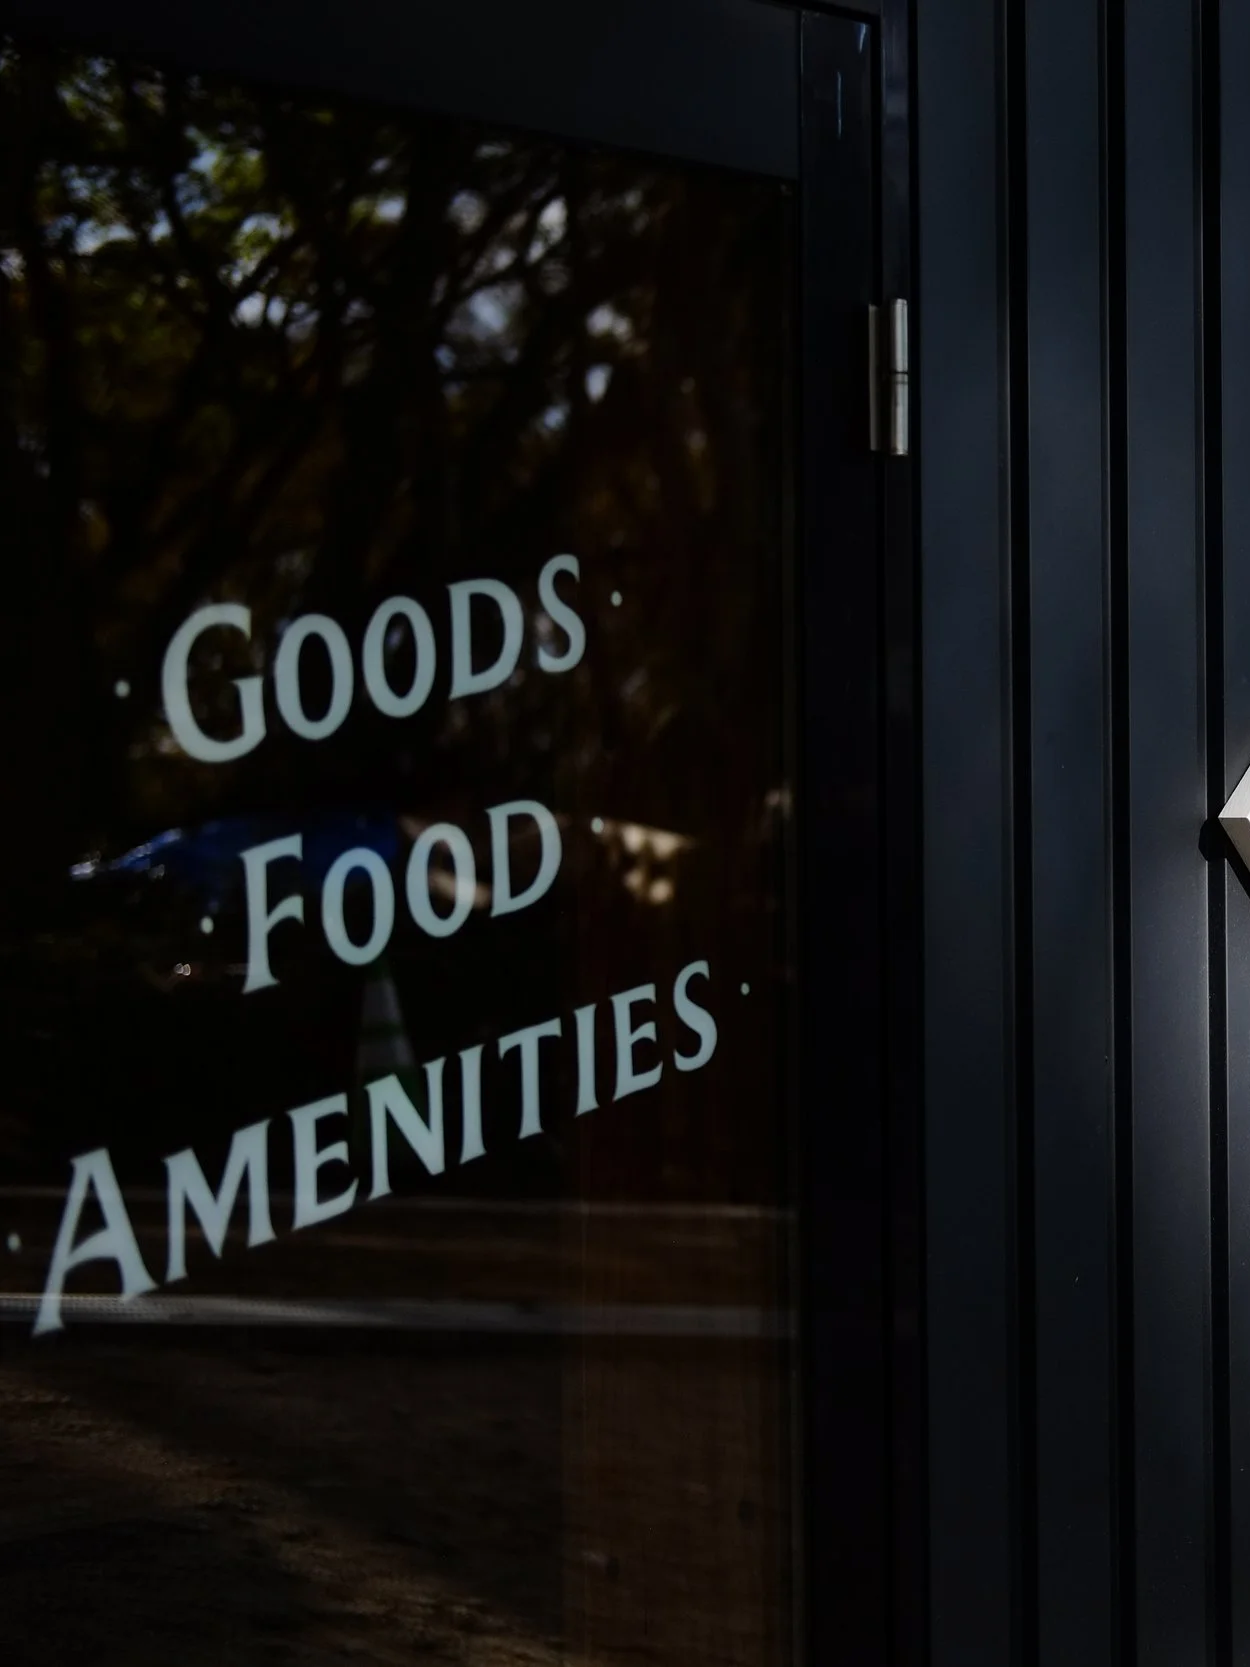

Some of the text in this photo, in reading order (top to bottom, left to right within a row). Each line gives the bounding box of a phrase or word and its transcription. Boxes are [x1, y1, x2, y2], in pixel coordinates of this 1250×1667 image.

[161, 554, 587, 764] GOODS
[241, 800, 563, 995] FOOD
[31, 960, 719, 1337] AMENITIES
